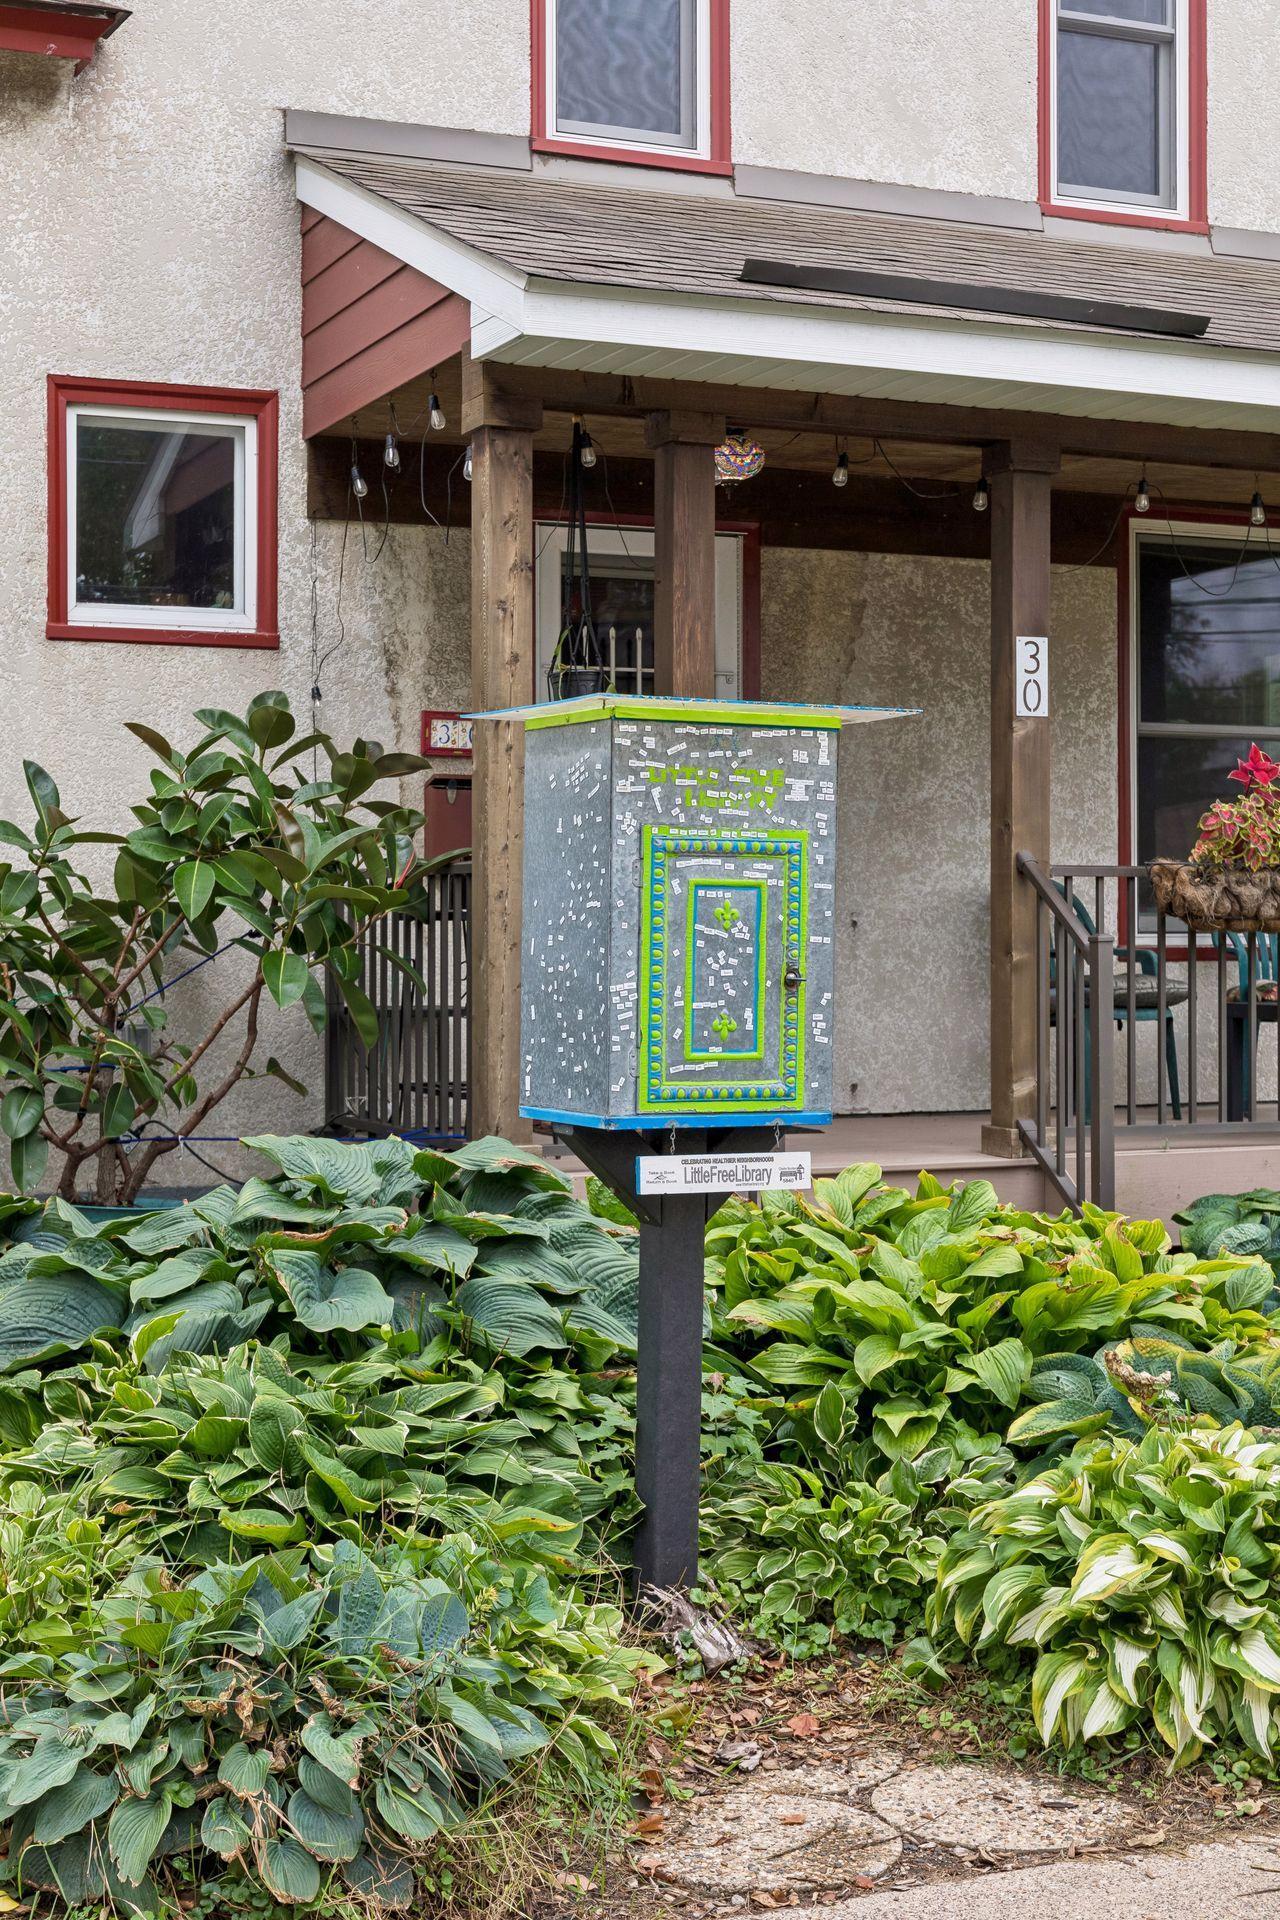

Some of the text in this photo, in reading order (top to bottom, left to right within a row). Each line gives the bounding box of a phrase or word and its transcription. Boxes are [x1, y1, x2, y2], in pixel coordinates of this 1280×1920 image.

[1022, 640, 1042, 713] 30
[438, 724, 473, 744] 3
[684, 1164, 773, 1185] LittleFreeLibrary
